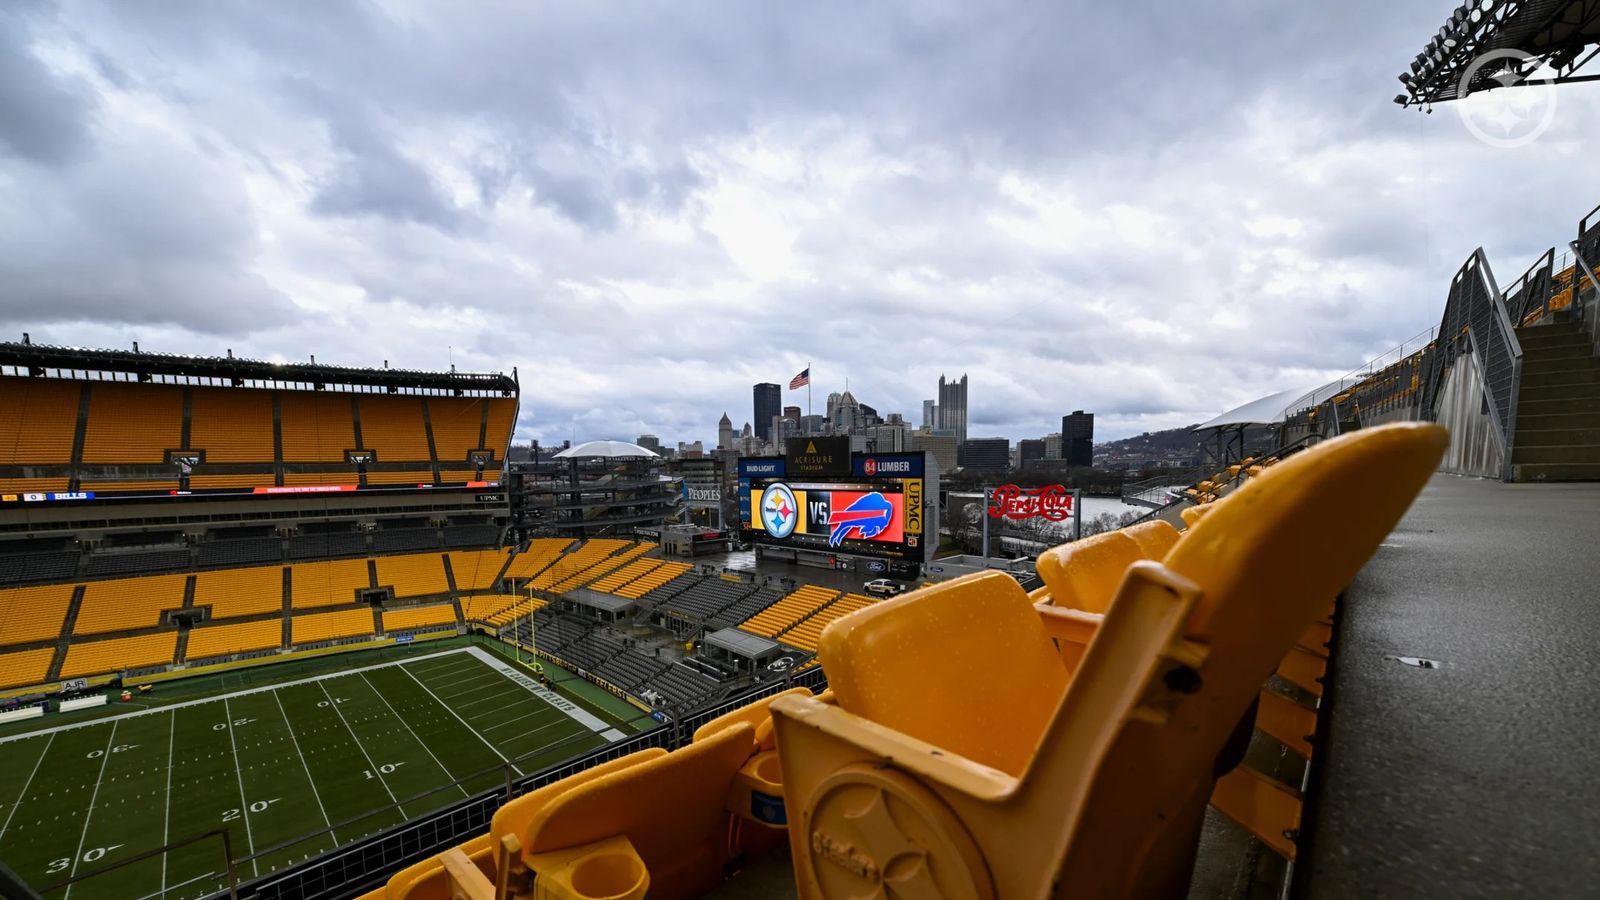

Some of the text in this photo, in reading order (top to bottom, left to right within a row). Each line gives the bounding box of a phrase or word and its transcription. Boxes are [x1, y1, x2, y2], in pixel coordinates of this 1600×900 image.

[795, 456, 833, 464] ACRISURE
[865, 461, 910, 472] 84 LUMBER
[54, 492, 87, 500] BILLS
[688, 488, 721, 501] PEOPLES
[909, 482, 919, 530] UPMC
[65, 680, 85, 689] AJR
[542, 692, 576, 711] CLEATS
